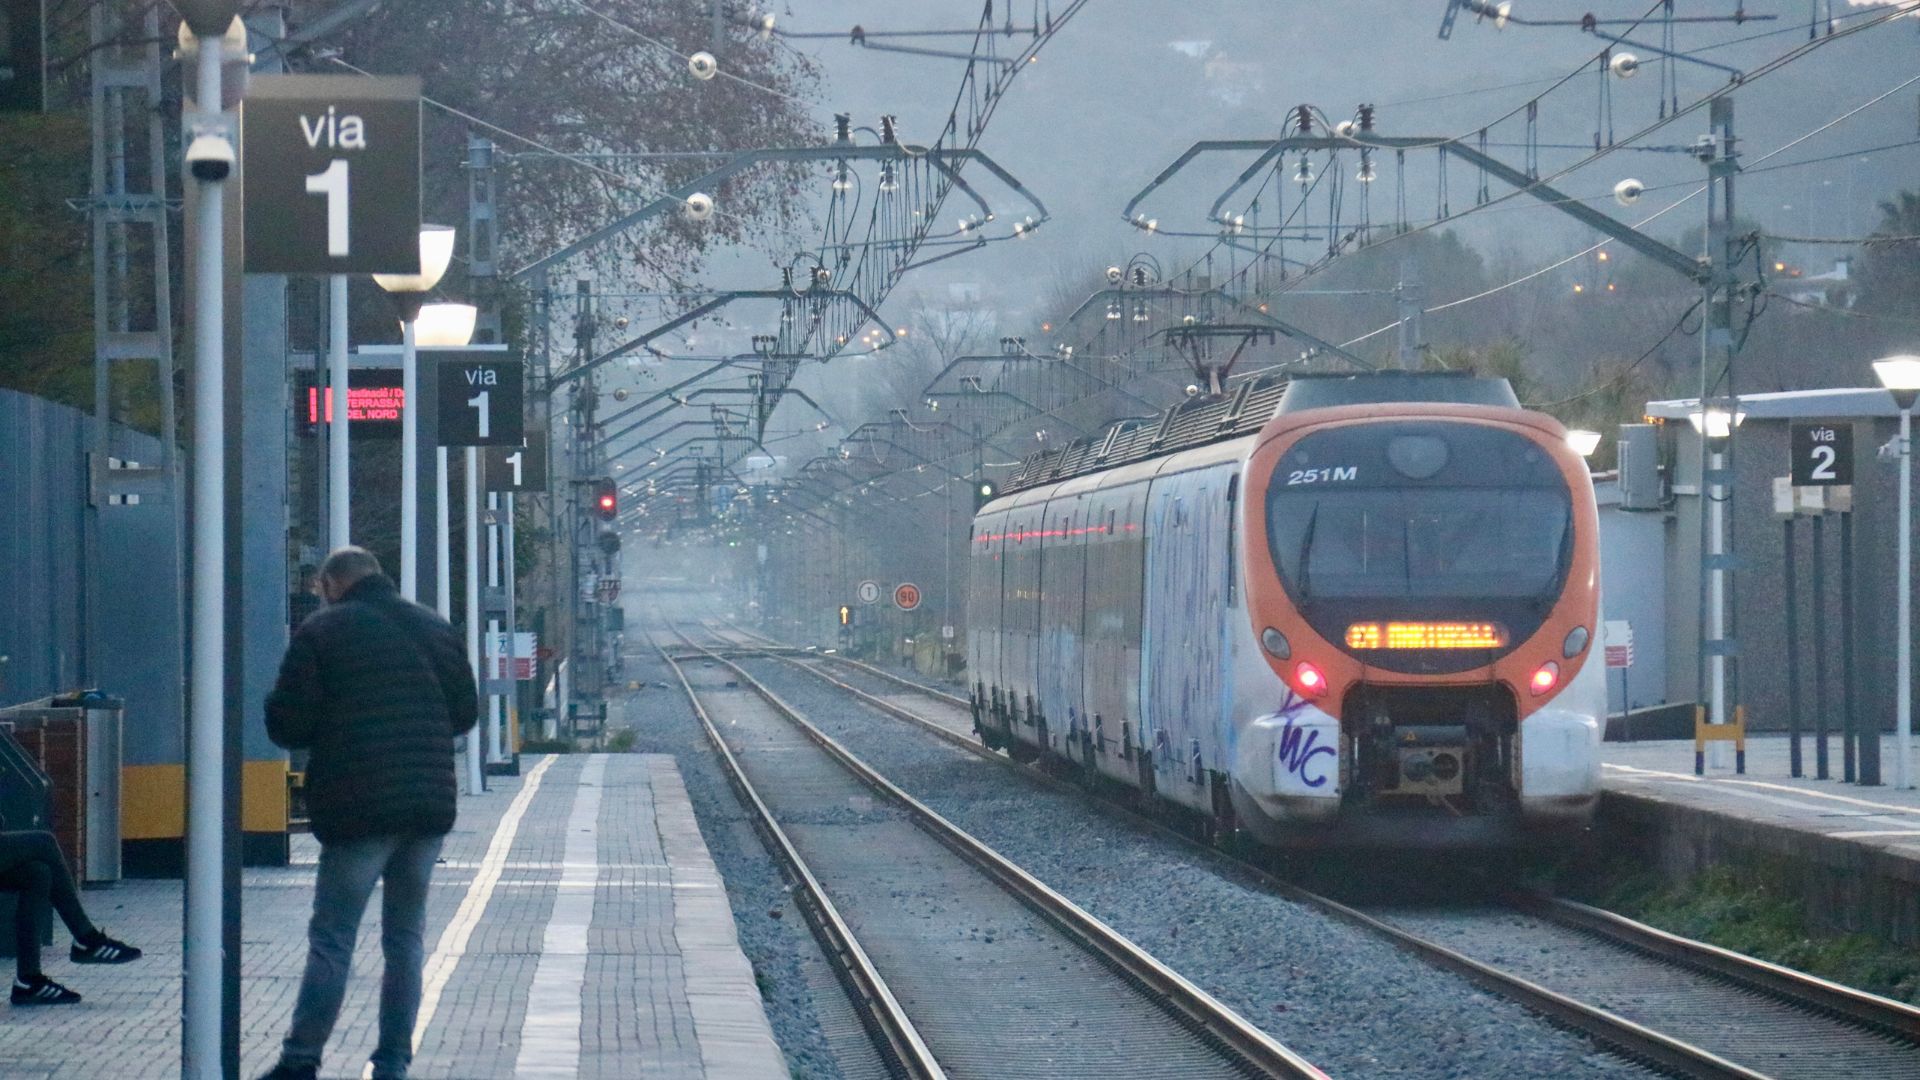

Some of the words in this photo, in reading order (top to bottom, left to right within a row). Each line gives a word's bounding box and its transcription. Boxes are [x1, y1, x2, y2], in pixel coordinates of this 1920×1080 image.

[300, 105, 366, 149] via
[305, 159, 349, 256] 1
[465, 365, 497, 385] via
[367, 409, 398, 419] NORD
[468, 391, 489, 437] 1
[1811, 426, 1835, 441] via
[506, 452, 522, 485] 1
[1811, 445, 1836, 479] 2
[1287, 466, 1358, 486] 251M
[900, 590, 915, 602] 90
